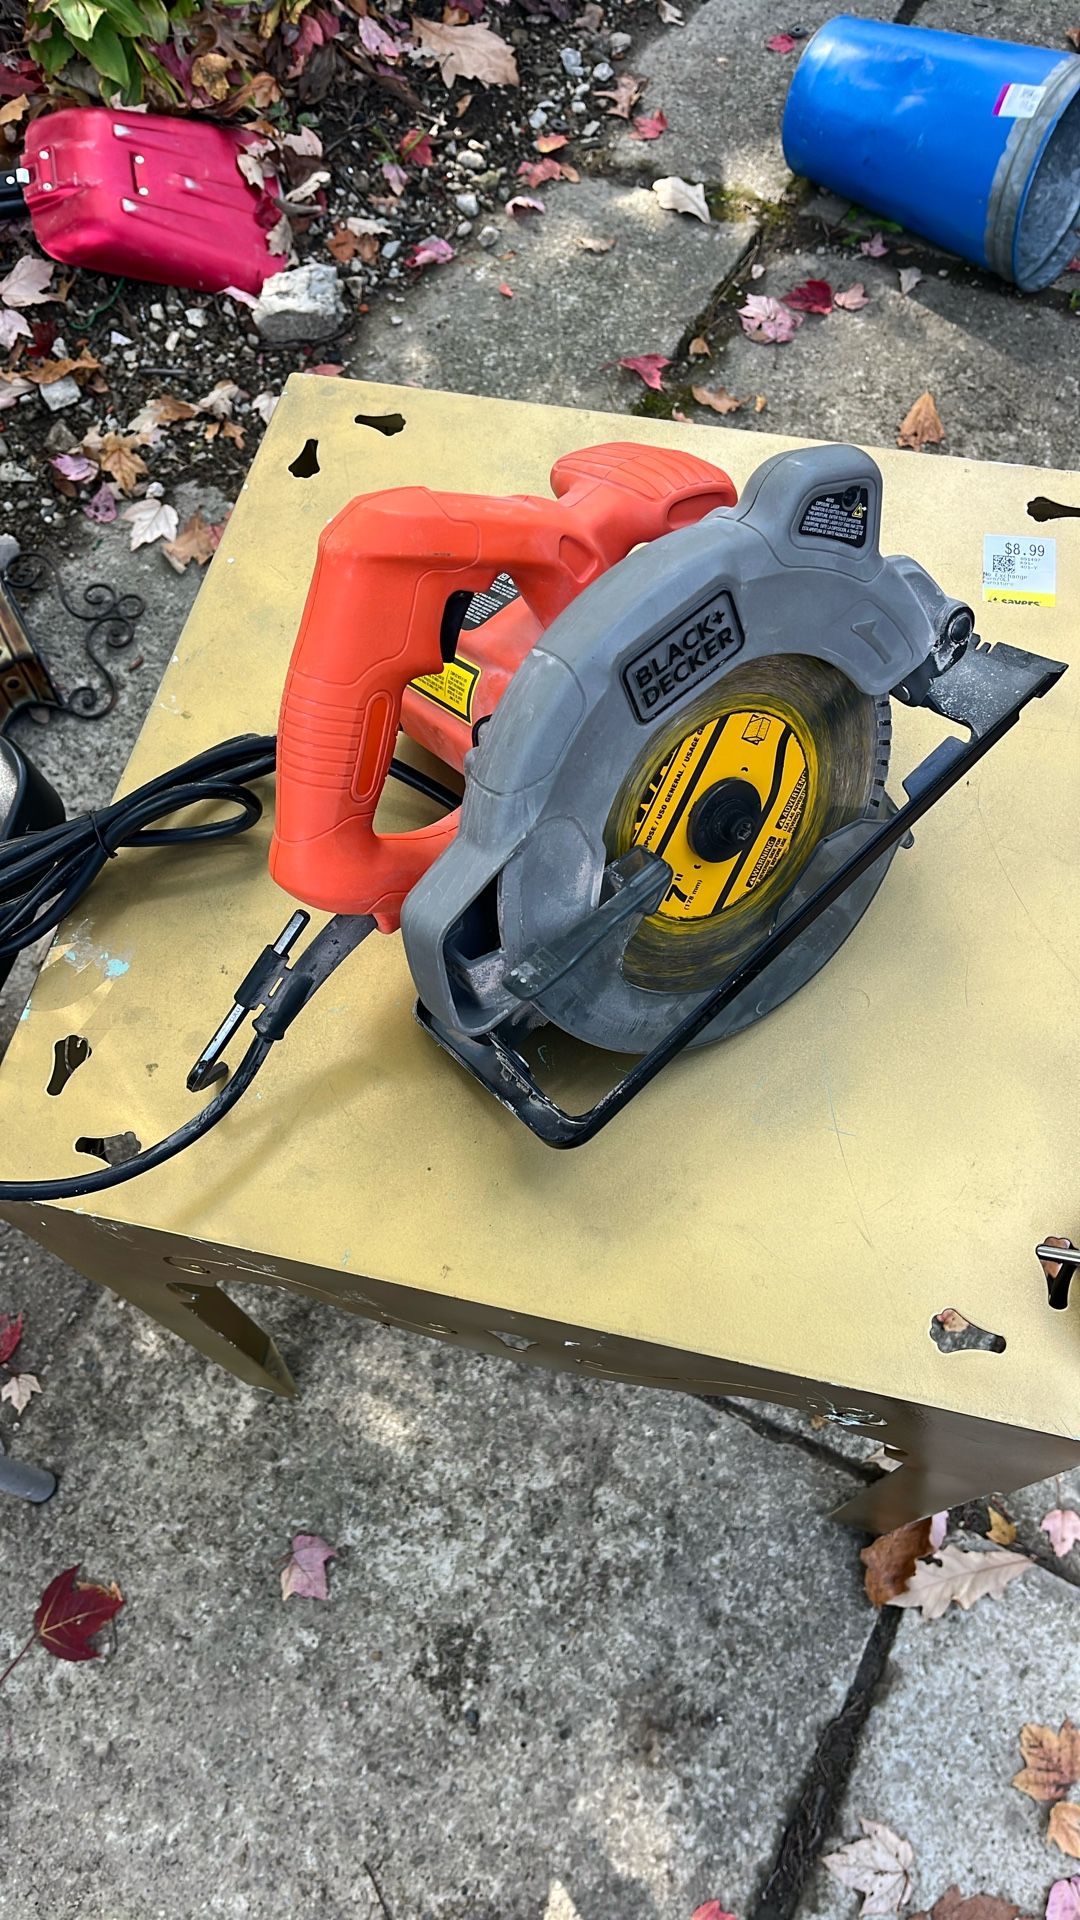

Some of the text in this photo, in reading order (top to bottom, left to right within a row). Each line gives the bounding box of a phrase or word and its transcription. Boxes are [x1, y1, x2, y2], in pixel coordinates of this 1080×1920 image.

[1004, 542, 1045, 557] $8.99
[641, 626, 734, 709] DECKER
[643, 826, 658, 848] POSE
[656, 804, 668, 820] USO
[665, 769, 684, 803] GENERAL
[684, 737, 700, 762] USAGE
[782, 770, 807, 817] ADVERTENC
